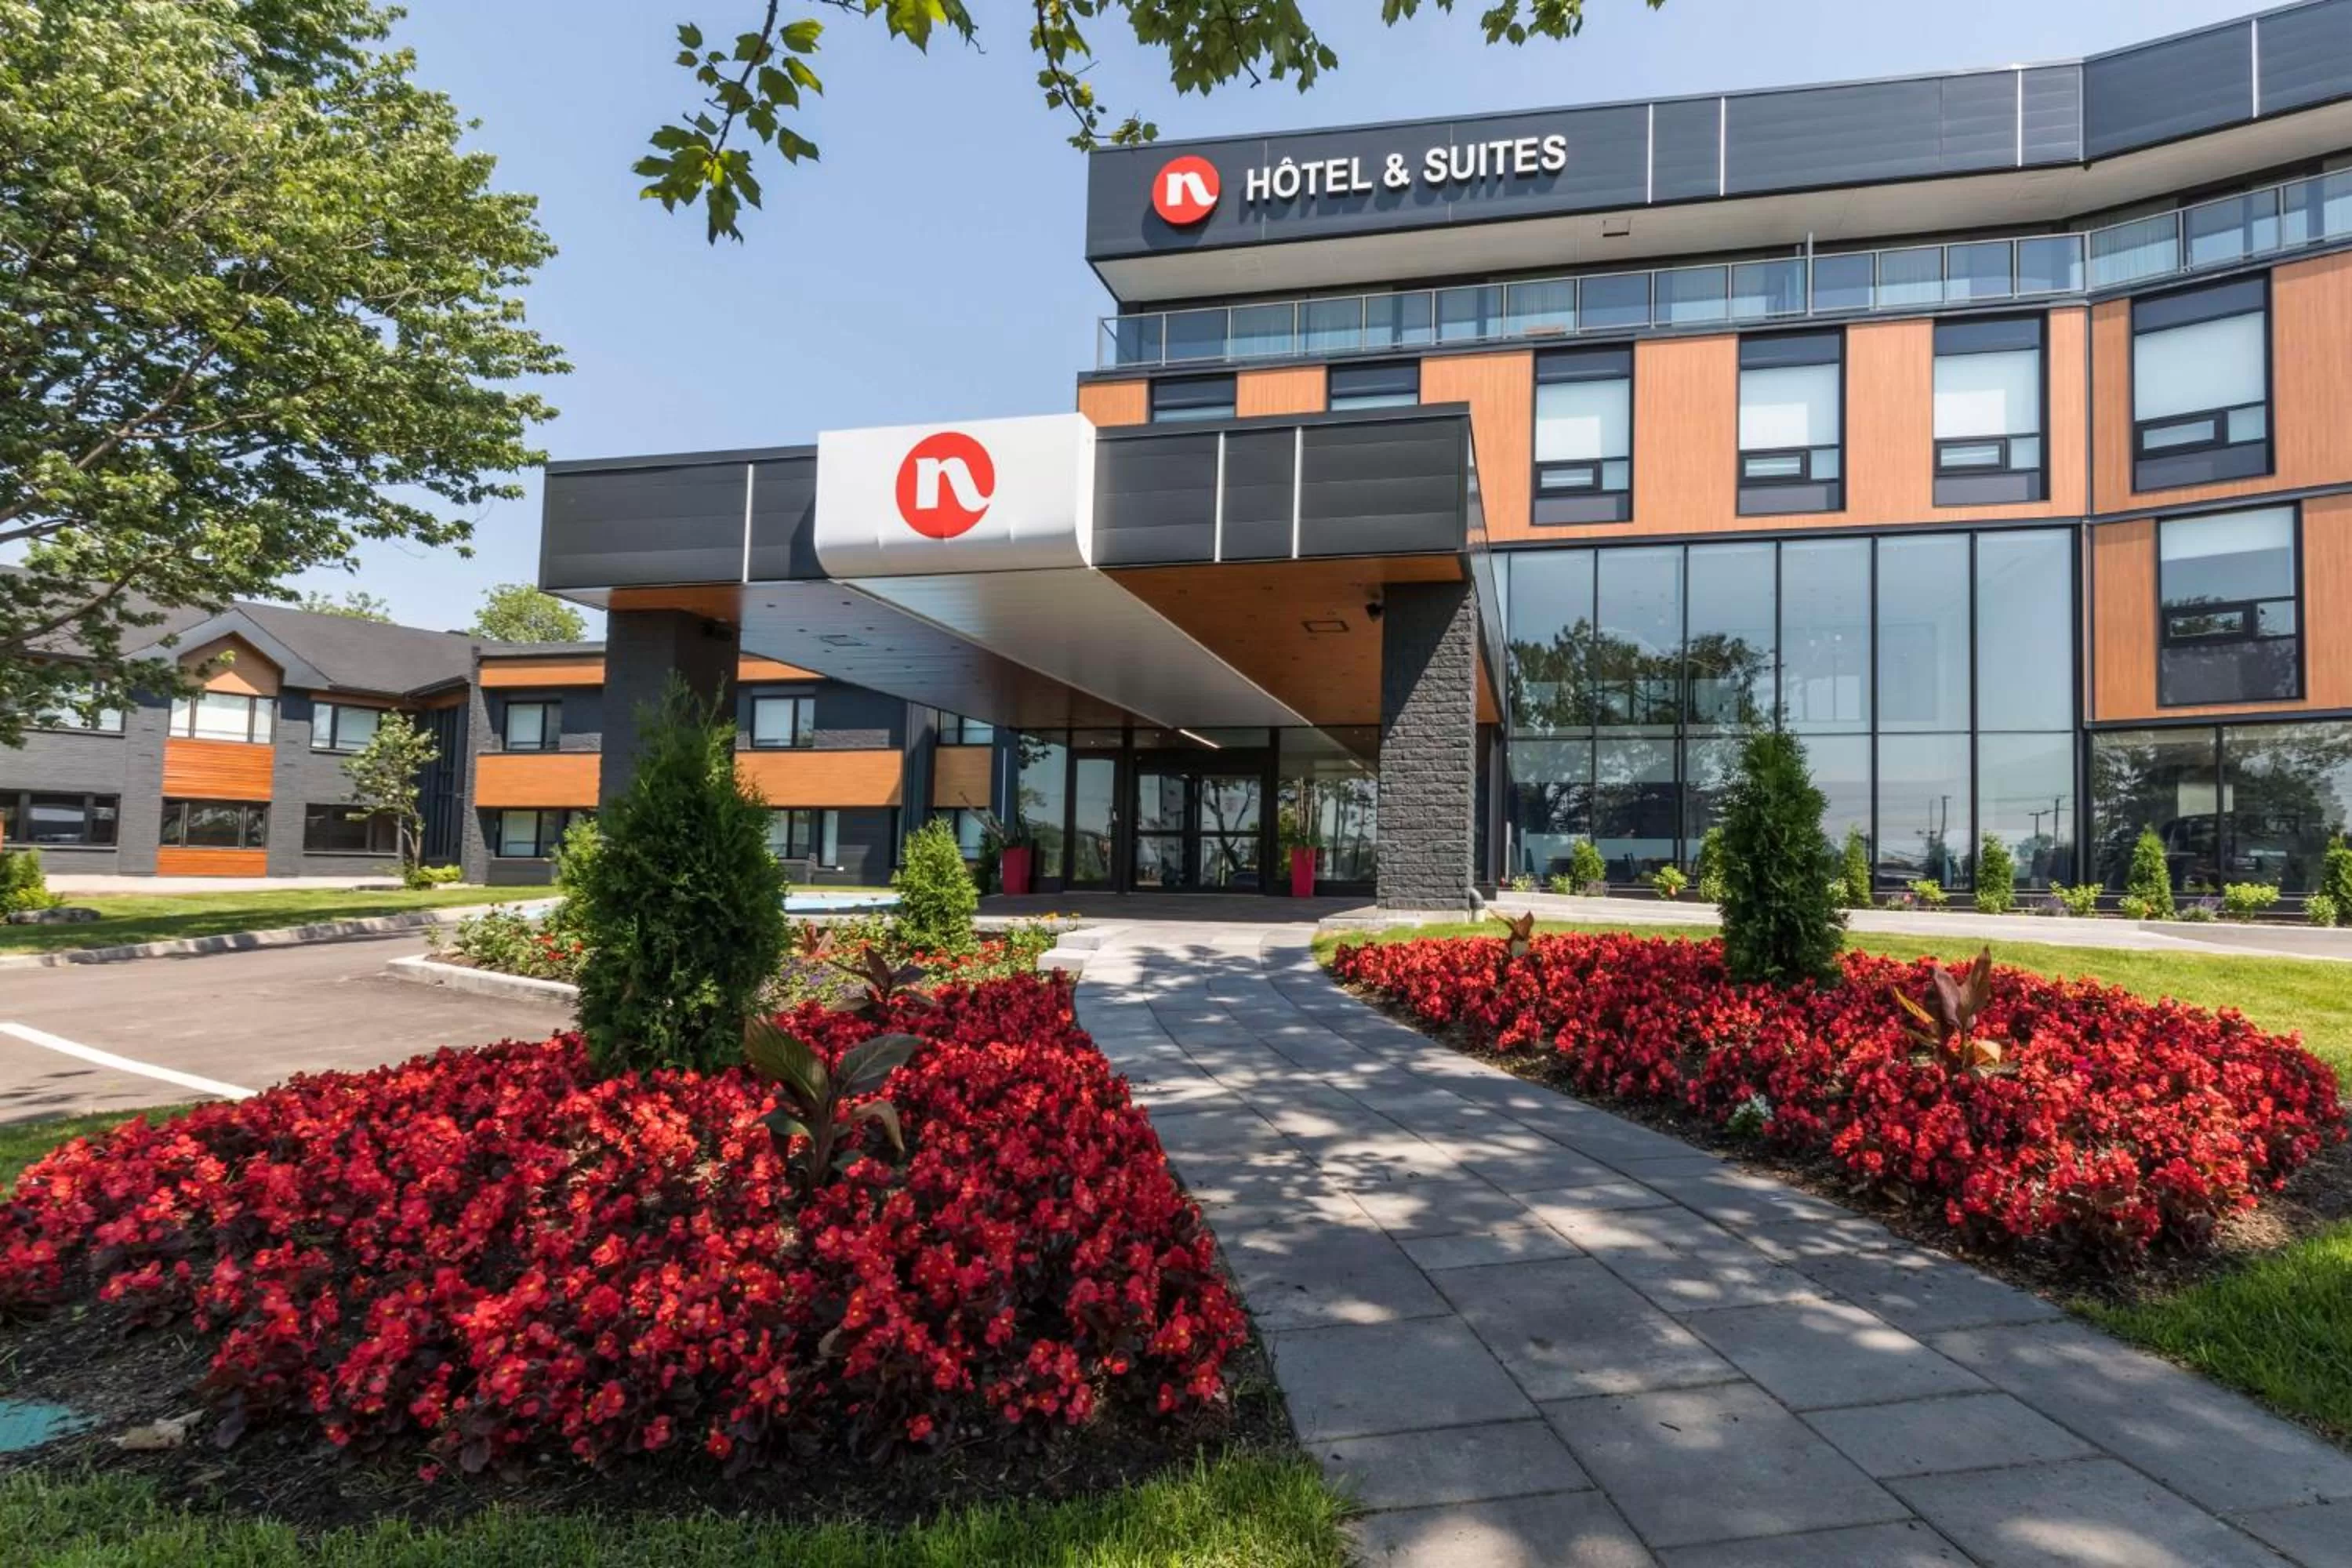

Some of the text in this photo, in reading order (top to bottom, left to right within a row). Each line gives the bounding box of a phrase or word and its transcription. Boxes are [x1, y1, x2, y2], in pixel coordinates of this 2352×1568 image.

[1247, 158, 1372, 201] HÔTEL
[1384, 153, 1410, 186] &
[1424, 135, 1566, 183] SUITES
